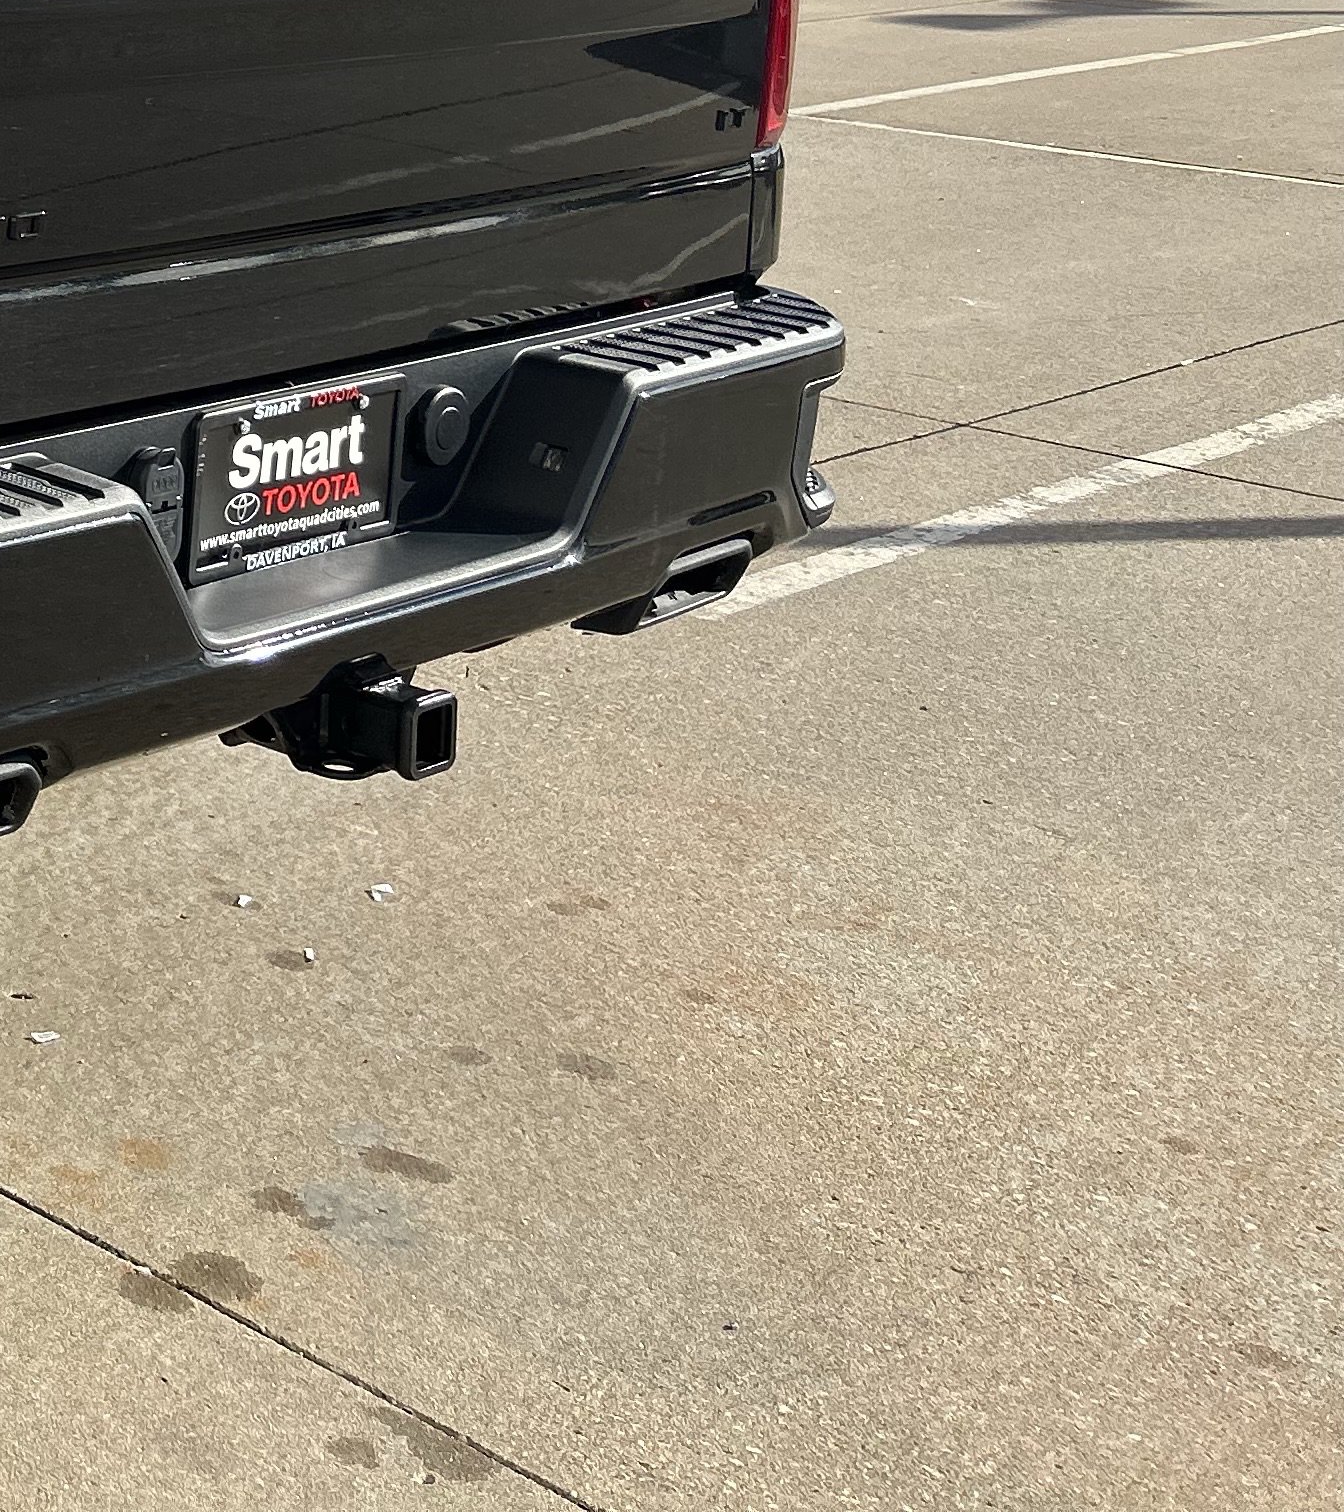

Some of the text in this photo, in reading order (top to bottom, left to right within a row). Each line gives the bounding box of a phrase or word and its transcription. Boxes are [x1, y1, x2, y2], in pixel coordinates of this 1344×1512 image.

[253, 386, 362, 420] Smart TOYOTA
[228, 414, 365, 489] Smart
[262, 471, 361, 516] TOYOTA
[200, 500, 380, 552] www.smarttoyotaquadcities.com
[245, 531, 348, 571] DAVENPORT, IA
